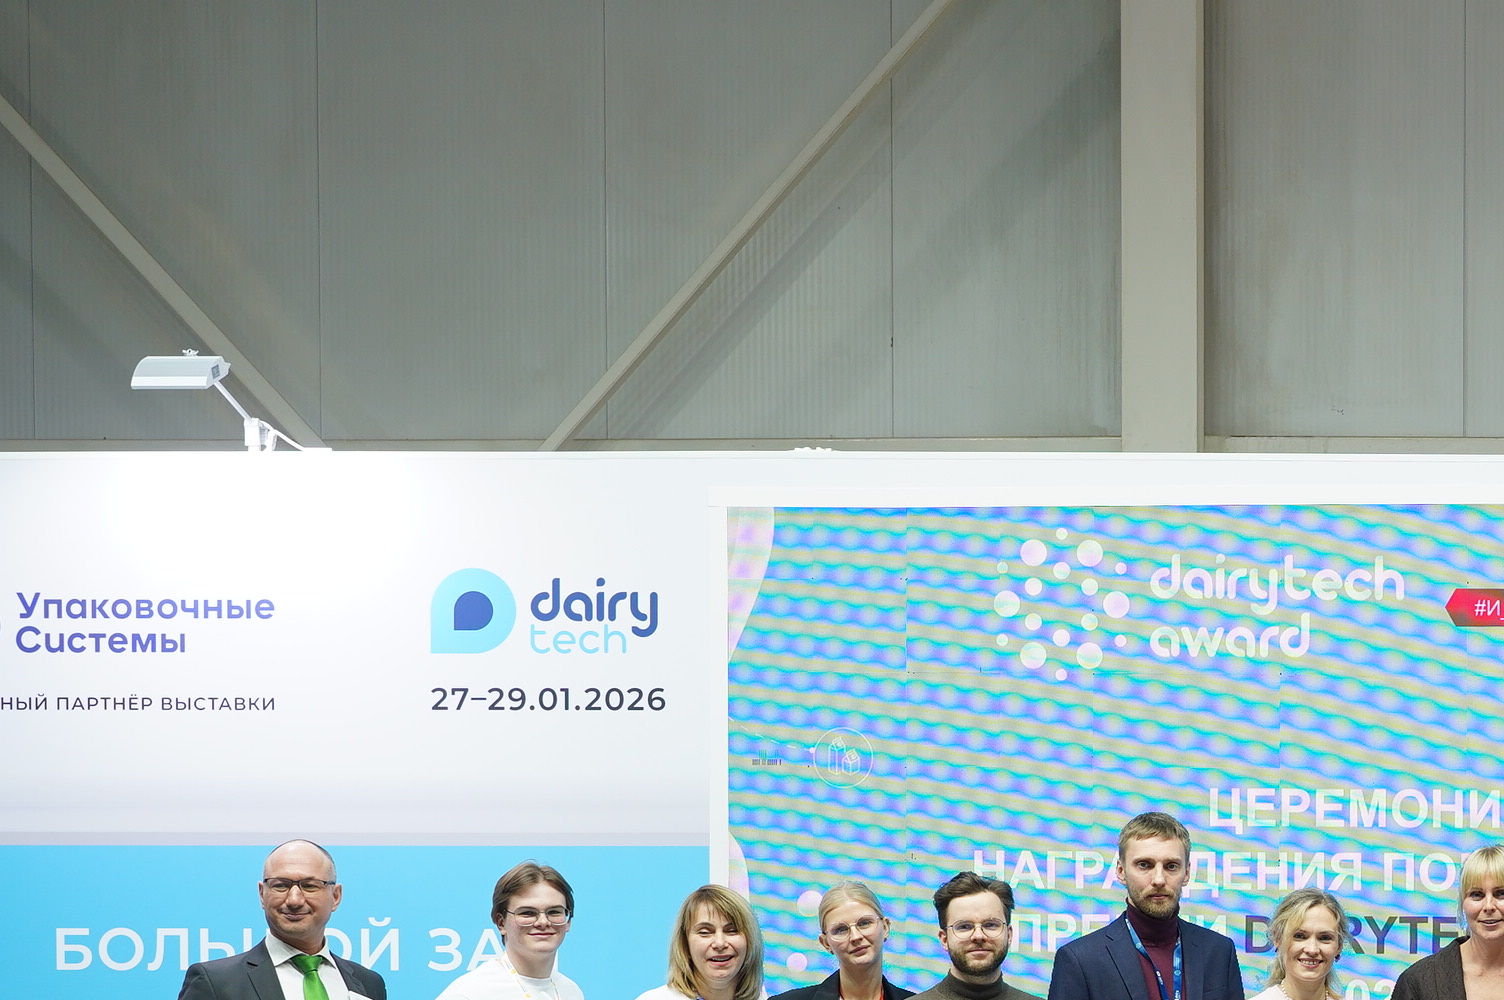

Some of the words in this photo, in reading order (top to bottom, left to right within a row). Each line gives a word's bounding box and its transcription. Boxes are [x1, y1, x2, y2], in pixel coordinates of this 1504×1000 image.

[1150, 554, 1405, 616] dairytech
[16, 592, 275, 619] Упаковочные
[530, 577, 658, 640] dairy
[16, 626, 185, 653] Системы
[530, 623, 627, 654] tech
[1150, 611, 1310, 658] award
[57, 694, 152, 710] ПАРТНЁР
[162, 697, 274, 710] ВЫСТАВКИ
[429, 928, 559, 971] ЗА
